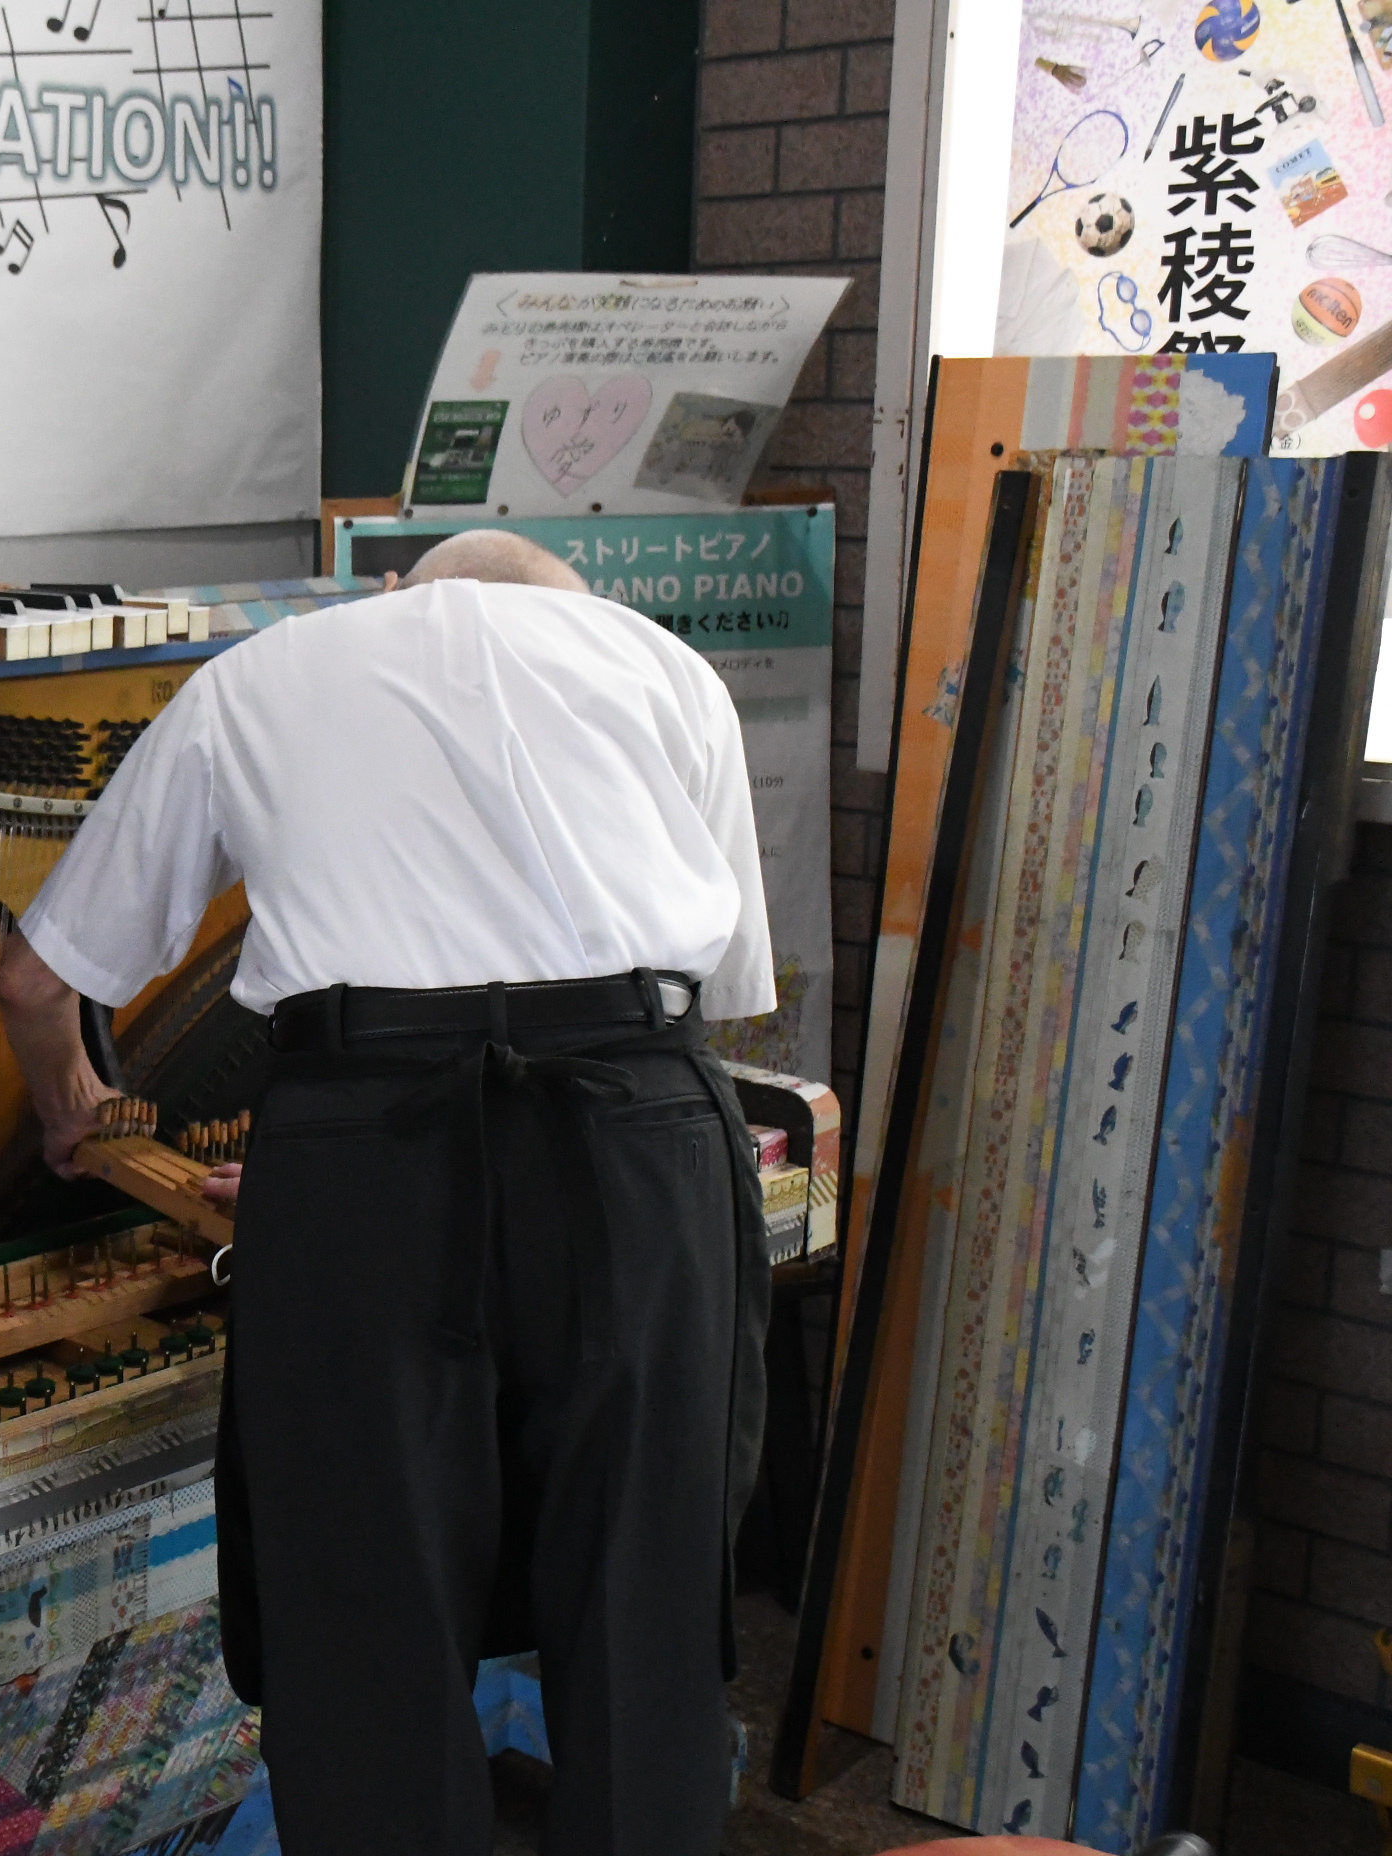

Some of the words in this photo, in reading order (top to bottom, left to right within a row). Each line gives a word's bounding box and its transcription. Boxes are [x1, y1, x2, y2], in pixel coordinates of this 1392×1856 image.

[1275, 147, 1312, 173] COMET
[566, 532, 771, 565] ストリートピアノ
[694, 571, 804, 601] PIANO
